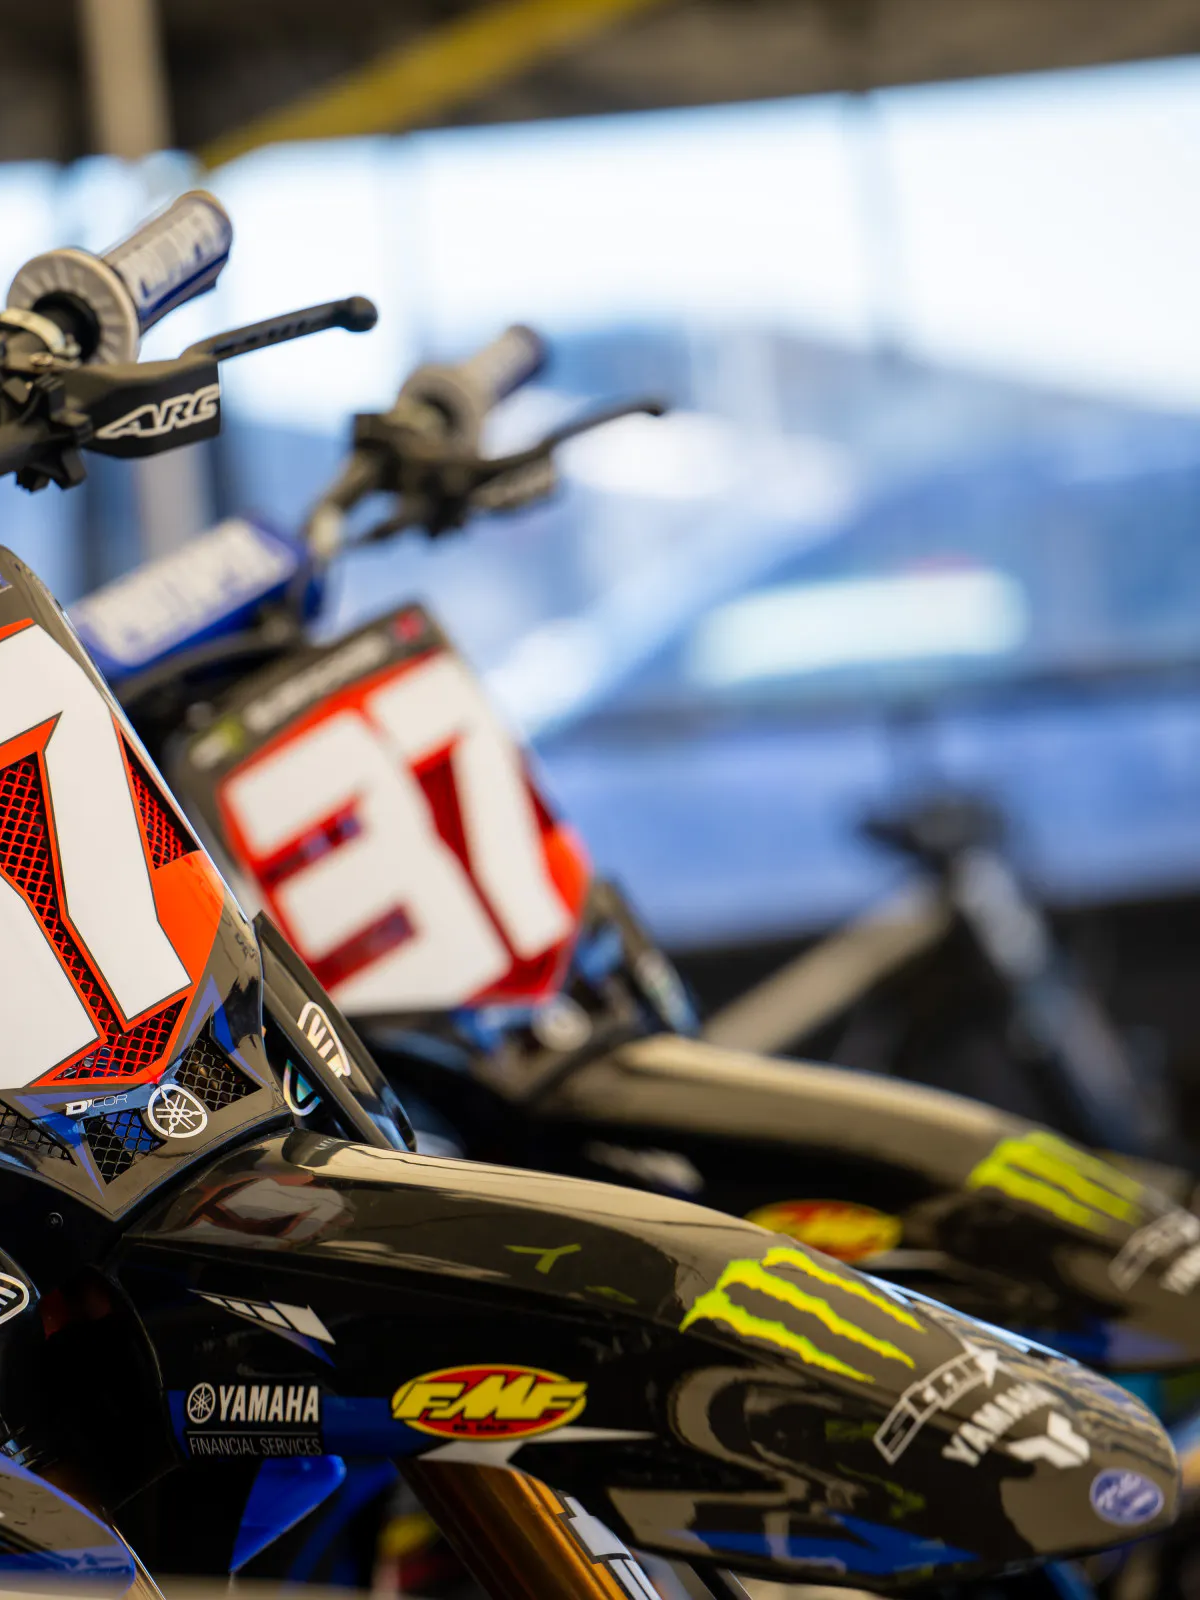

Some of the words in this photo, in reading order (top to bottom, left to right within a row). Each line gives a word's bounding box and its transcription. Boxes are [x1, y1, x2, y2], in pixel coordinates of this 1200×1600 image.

[222, 645, 575, 1014] 37
[219, 1385, 319, 1423] YAMAHA
[393, 1374, 589, 1421] FMF
[189, 1437, 258, 1456] FINANCIAL
[260, 1437, 323, 1457] SERVICES
